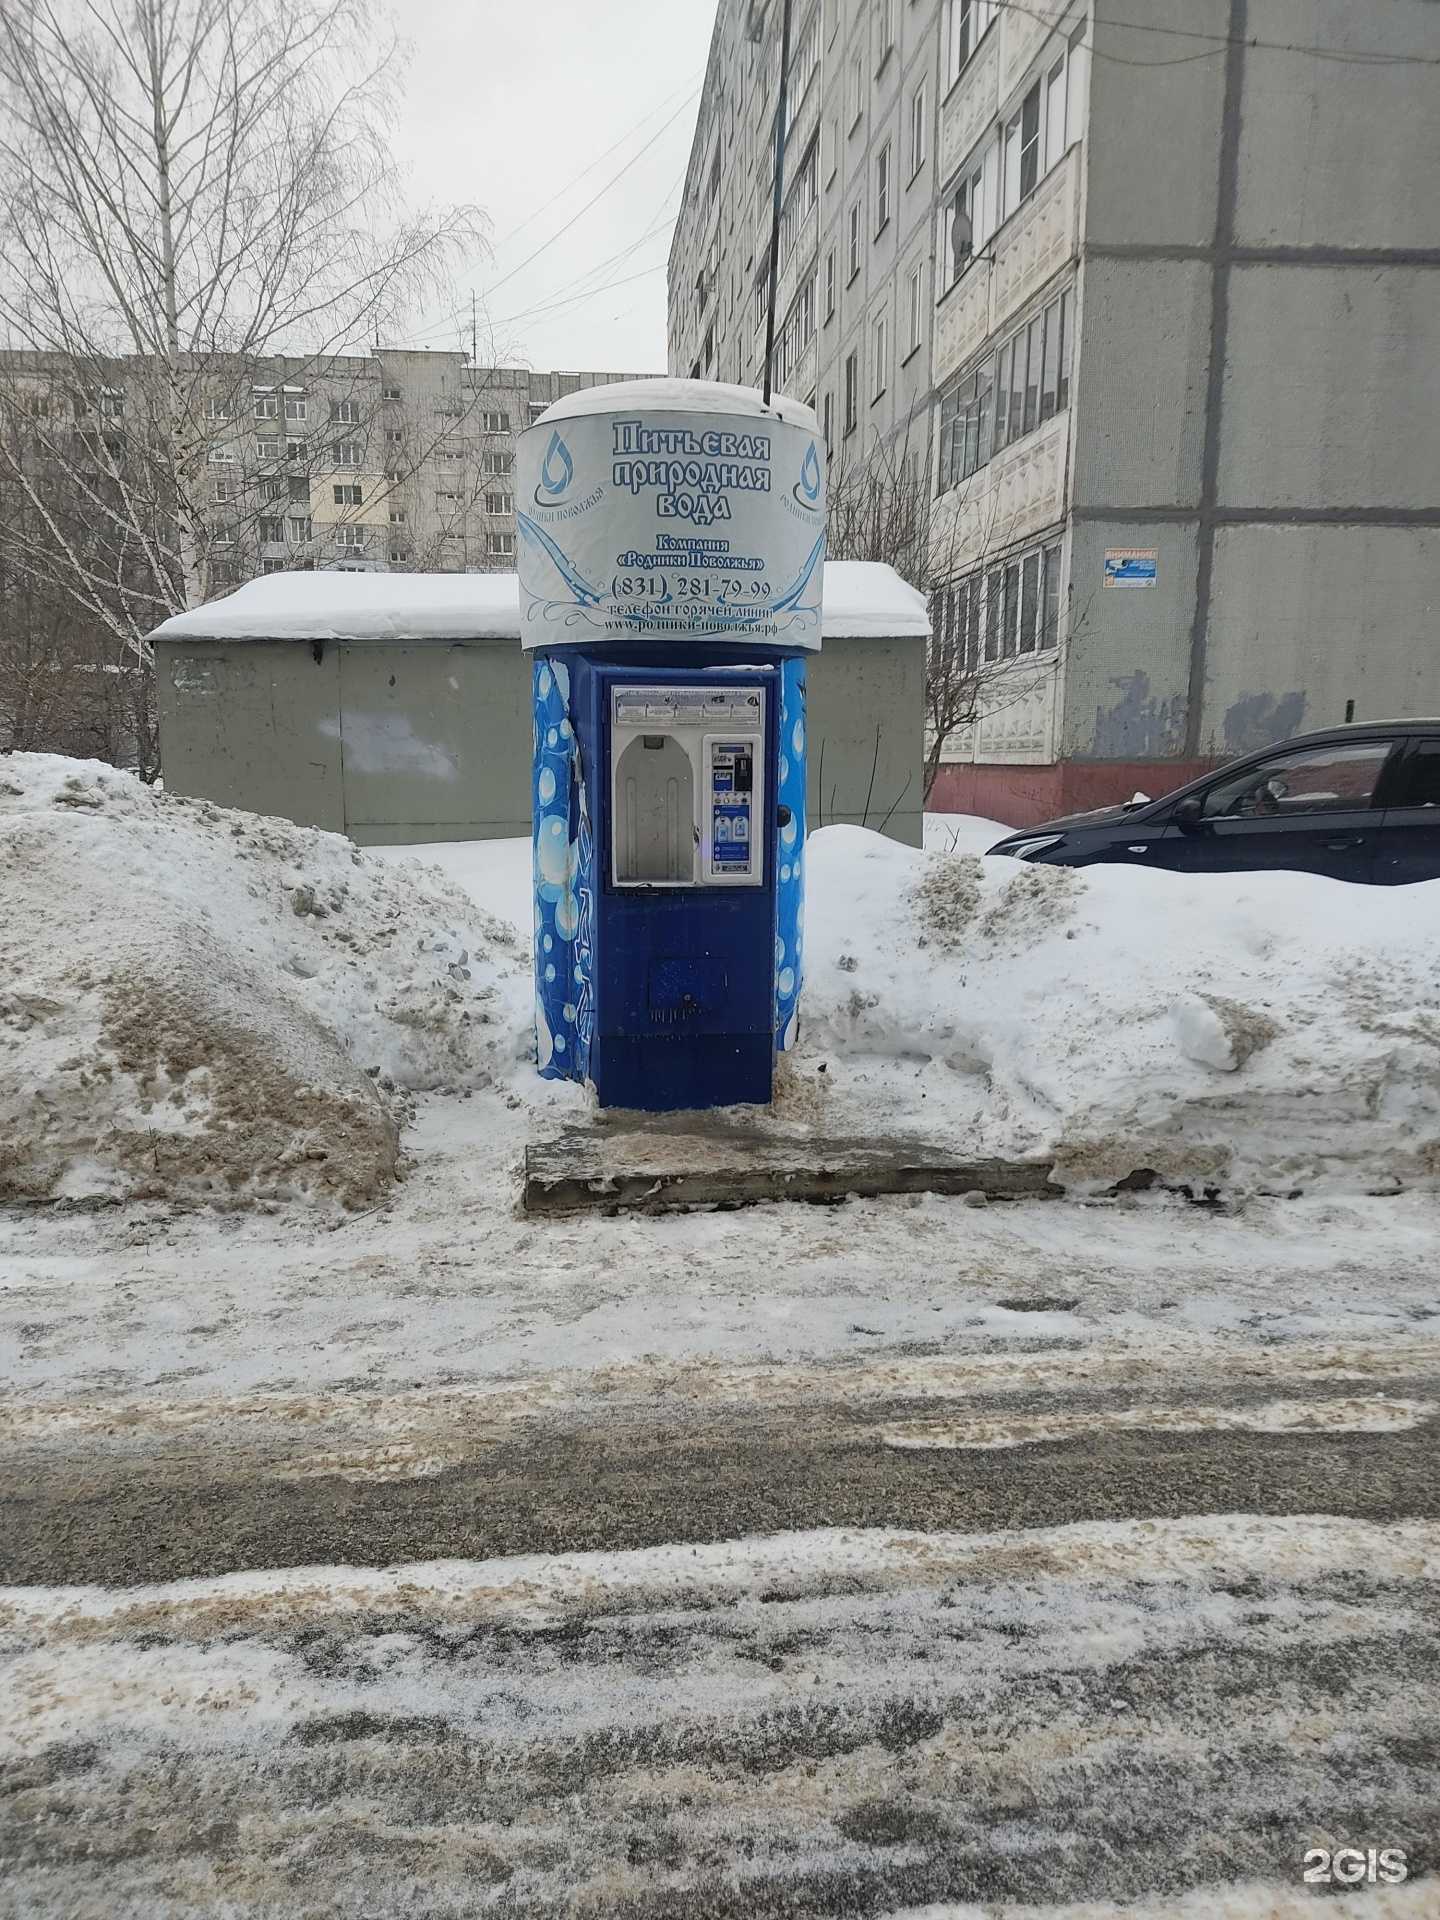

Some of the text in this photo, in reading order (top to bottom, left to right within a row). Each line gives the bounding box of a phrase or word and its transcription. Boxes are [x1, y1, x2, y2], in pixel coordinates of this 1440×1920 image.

[613, 420, 770, 460] Питьевая
[613, 460, 771, 495] природная
[657, 493, 731, 526] вода
[656, 534, 730, 552] Компания
[617, 551, 765, 571] «Родники Поволжья»
[611, 574, 771, 600] (831) 281-79-99
[607, 601, 774, 621] телефон горячей линии
[604, 619, 778, 636] www.родники-поволжья.рф
